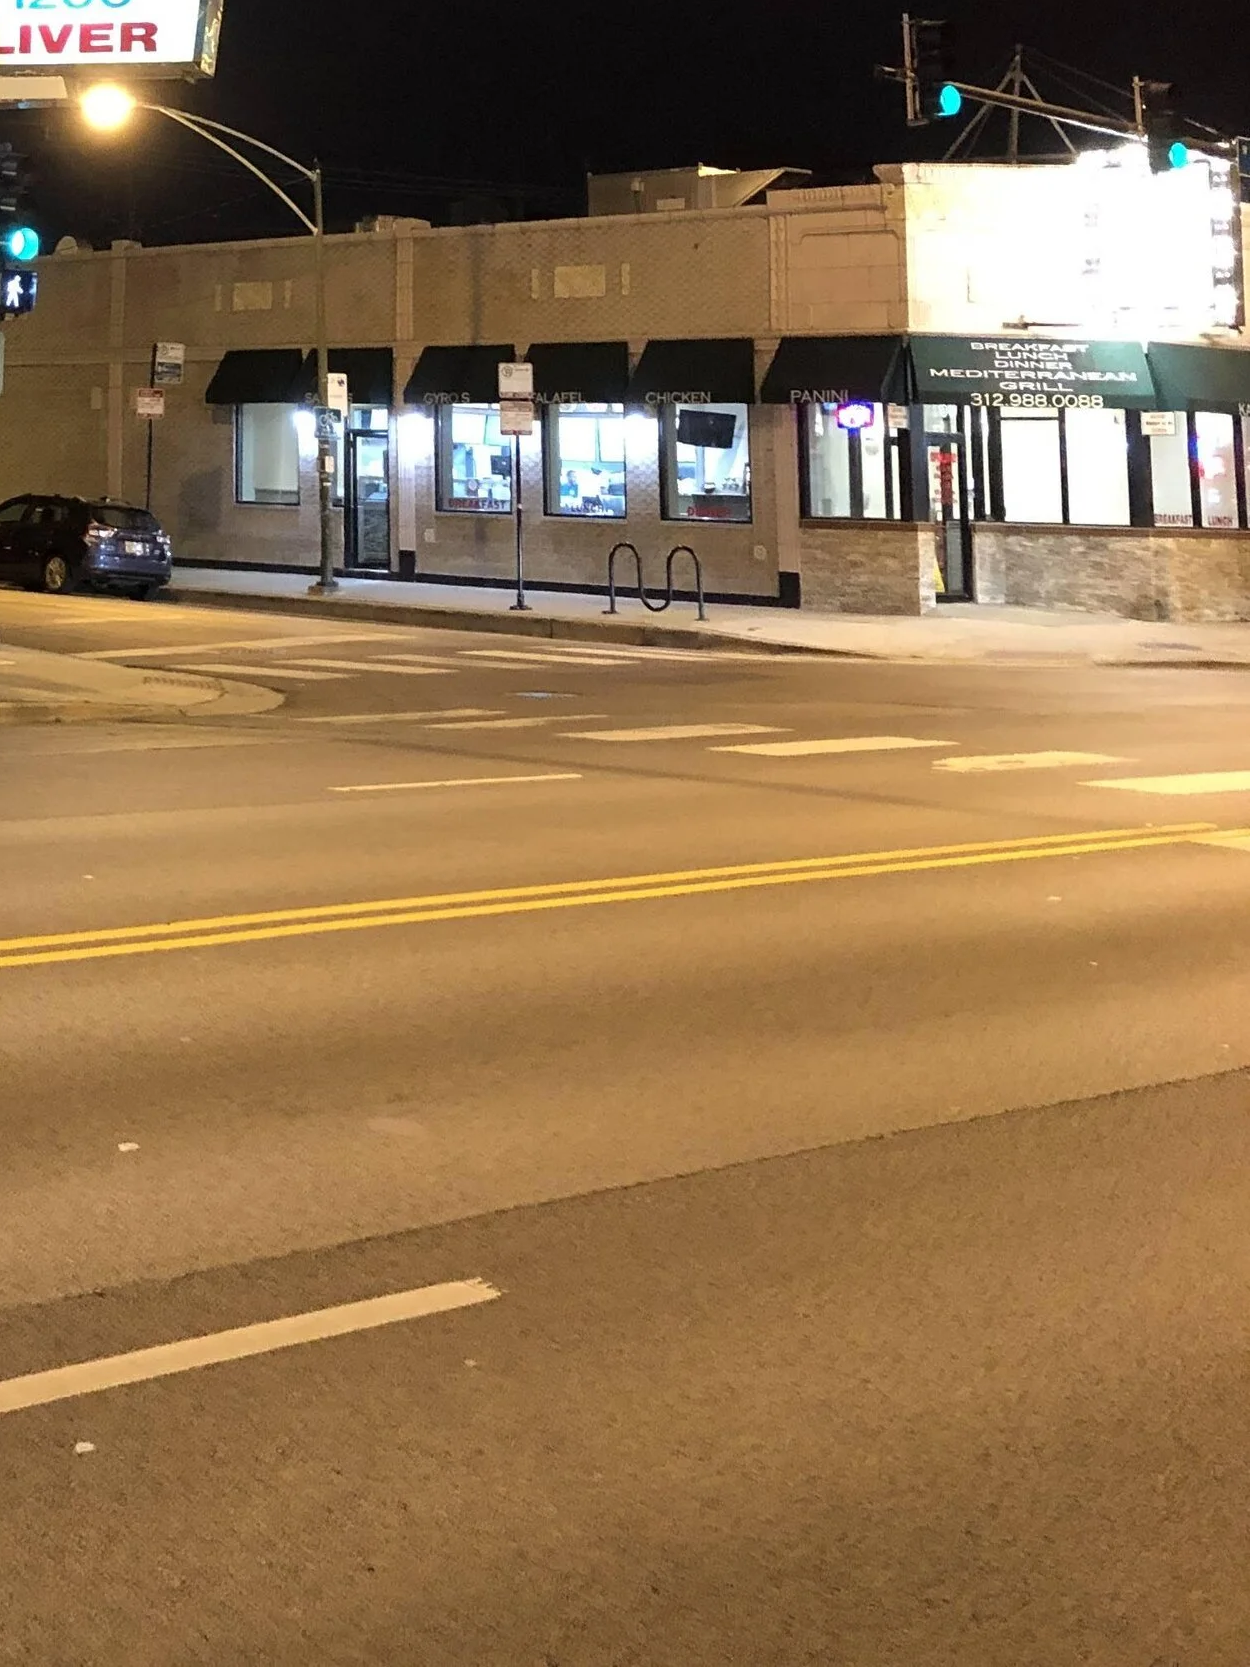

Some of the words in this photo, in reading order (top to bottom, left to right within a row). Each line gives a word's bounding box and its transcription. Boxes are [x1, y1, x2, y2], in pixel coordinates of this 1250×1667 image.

[970, 341, 1090, 353] BREAKFAST
[995, 350, 1068, 362] LUNCH
[994, 360, 1073, 371] DINNER
[929, 368, 1138, 383] MEDITERRANEAN
[999, 381, 1074, 393] GRILL
[423, 391, 471, 404] GYROS
[645, 391, 712, 404] CHICKEN
[790, 389, 848, 403] PANINI
[970, 393, 1105, 409] 312.988.0088
